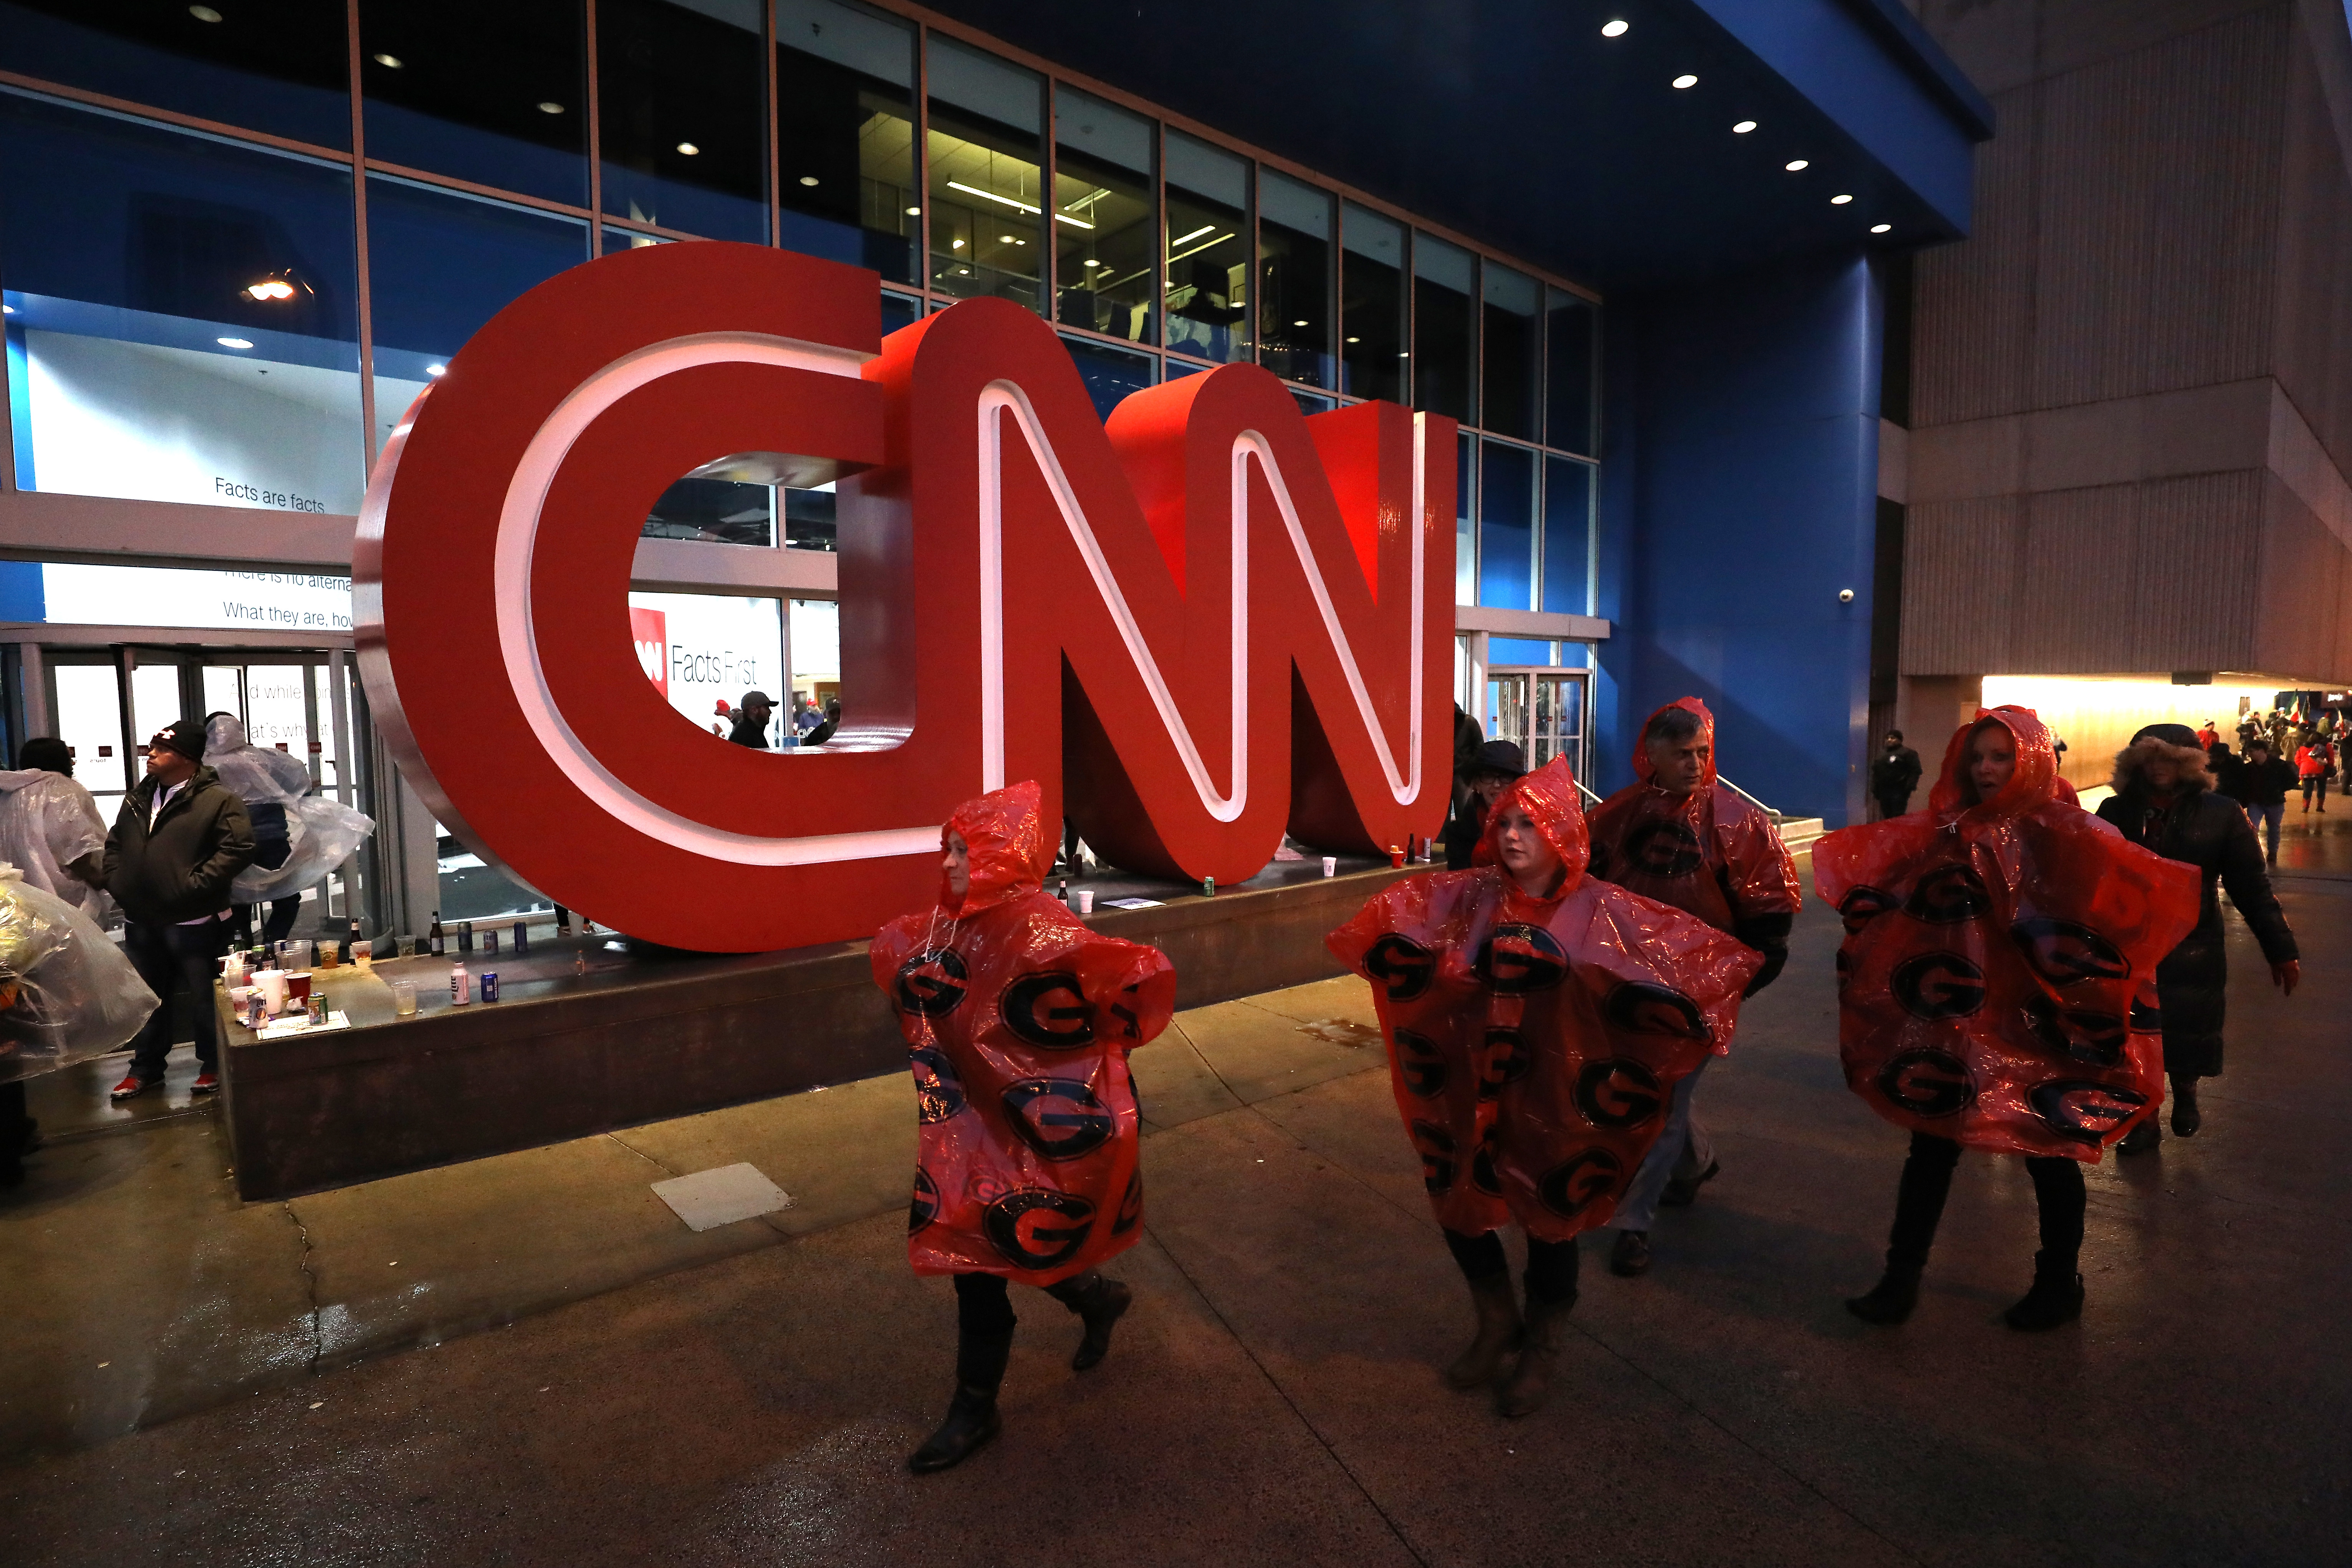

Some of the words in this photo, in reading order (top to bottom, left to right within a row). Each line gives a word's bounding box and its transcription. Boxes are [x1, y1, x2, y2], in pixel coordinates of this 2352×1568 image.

[215, 477, 258, 501] Facts
[262, 491, 286, 507] are
[290, 493, 325, 513] facts
[223, 601, 264, 620] What
[269, 606, 298, 626] they
[304, 612, 328, 627] are,
[353, 241, 1457, 952] CNN
[230, 684, 258, 699] Ad
[265, 684, 301, 699] while
[672, 645, 720, 683] Facts
[725, 651, 757, 685] First
[1002, 973, 1097, 1048] G
[1895, 954, 1986, 1018] G
[1574, 1058, 1661, 1128] G
[1879, 1050, 1973, 1115] G
[1001, 1077, 1112, 1160] G
[985, 1189, 1094, 1270] G
